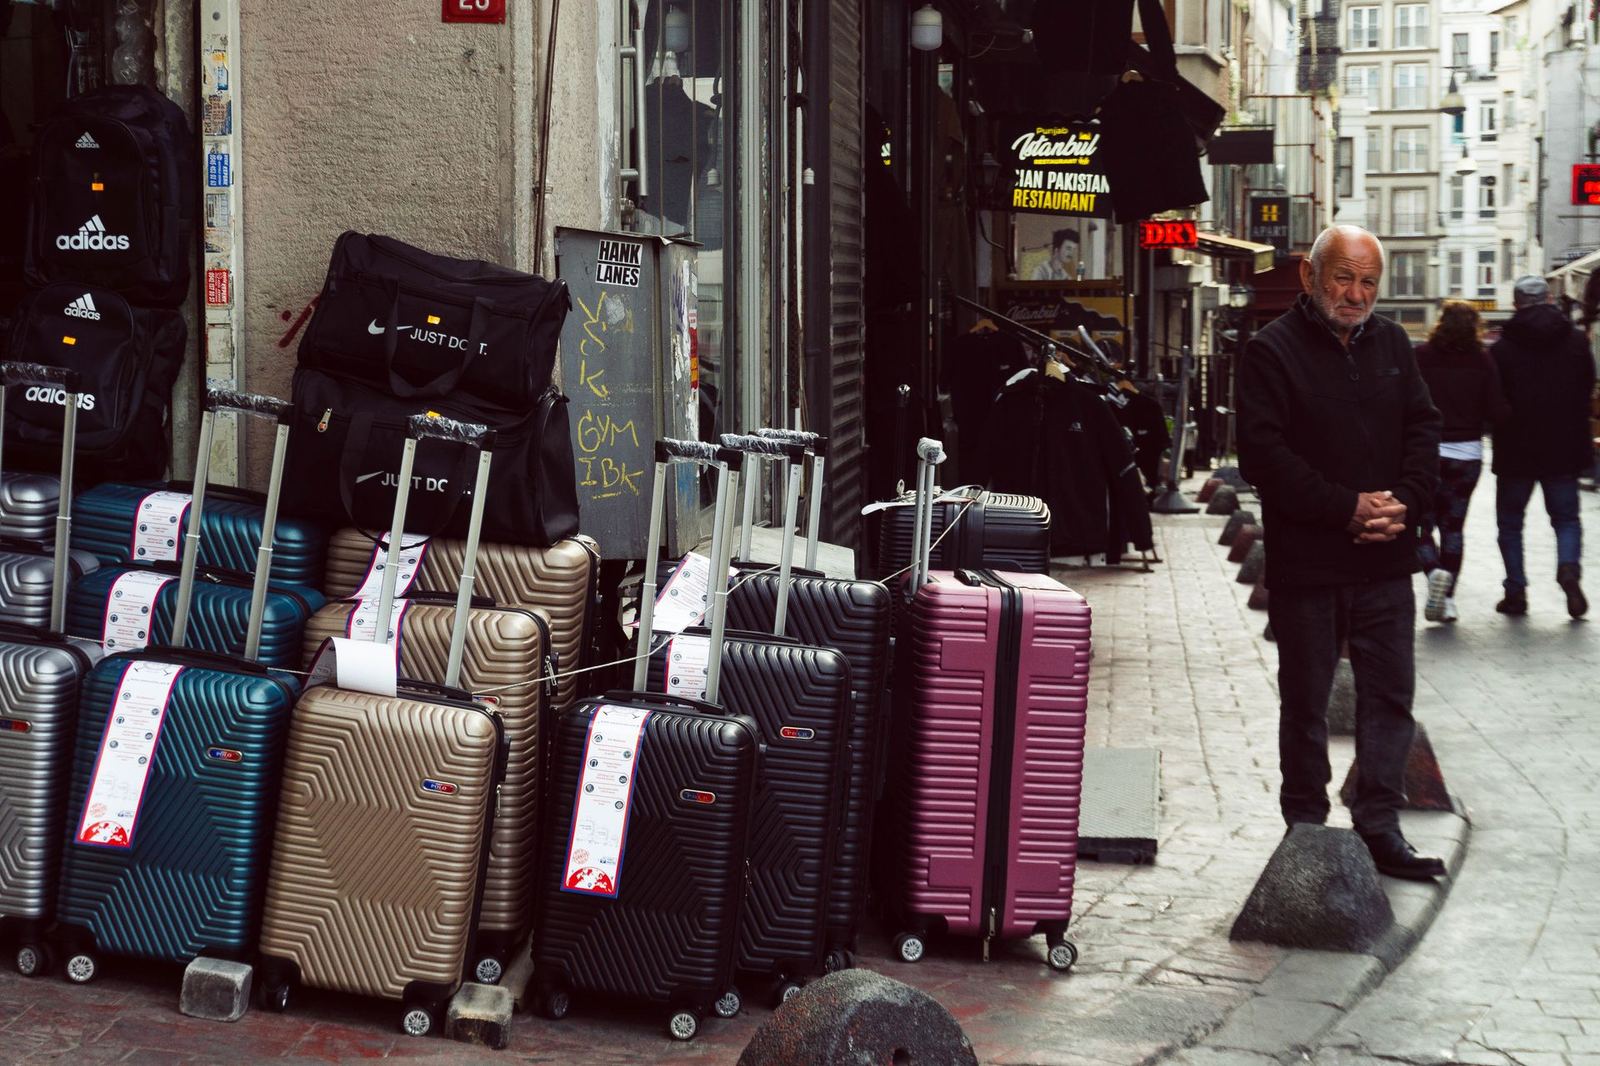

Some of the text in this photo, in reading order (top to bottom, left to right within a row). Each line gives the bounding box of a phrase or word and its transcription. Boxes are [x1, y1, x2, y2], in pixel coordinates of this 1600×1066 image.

[1036, 127, 1069, 136] Punjab
[75, 141, 100, 149] adidas
[1011, 132, 1101, 160] Istanbul
[1013, 189, 1097, 212] RESTAURANT
[56, 231, 130, 250] adidas
[598, 241, 641, 264] HANK
[596, 265, 639, 286] LANES
[64, 306, 101, 320] adidas
[410, 328, 446, 345] JUST
[578, 409, 639, 452] GYM
[381, 473, 422, 489] JUT
